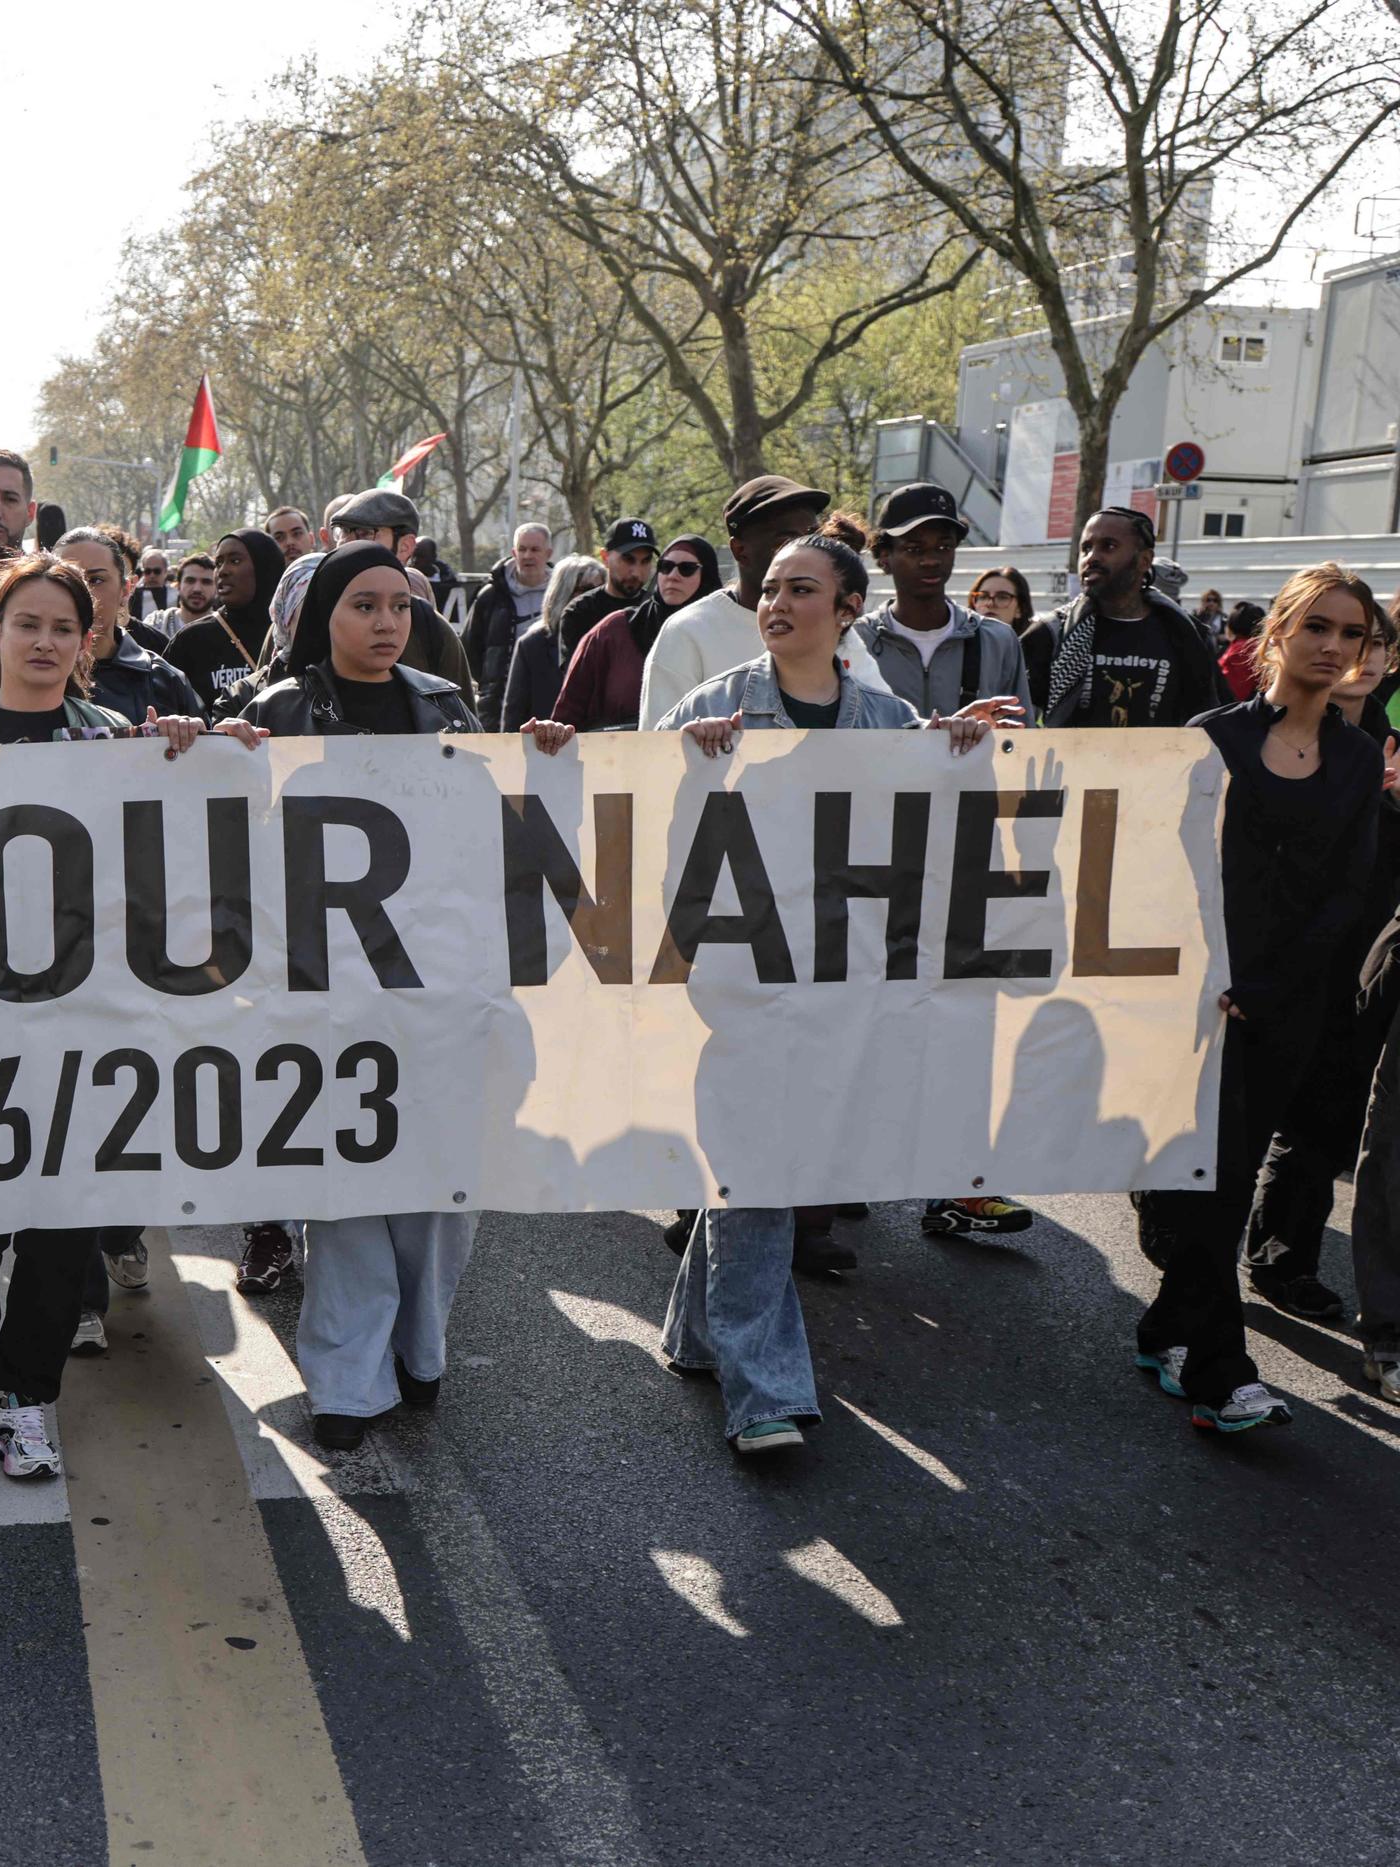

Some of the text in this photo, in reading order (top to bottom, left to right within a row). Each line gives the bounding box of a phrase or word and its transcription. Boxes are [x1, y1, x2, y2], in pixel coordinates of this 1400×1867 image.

[632, 523, 648, 538] NY
[1096, 654, 1158, 670] Bradley
[502, 789, 1181, 987] NAHEL
